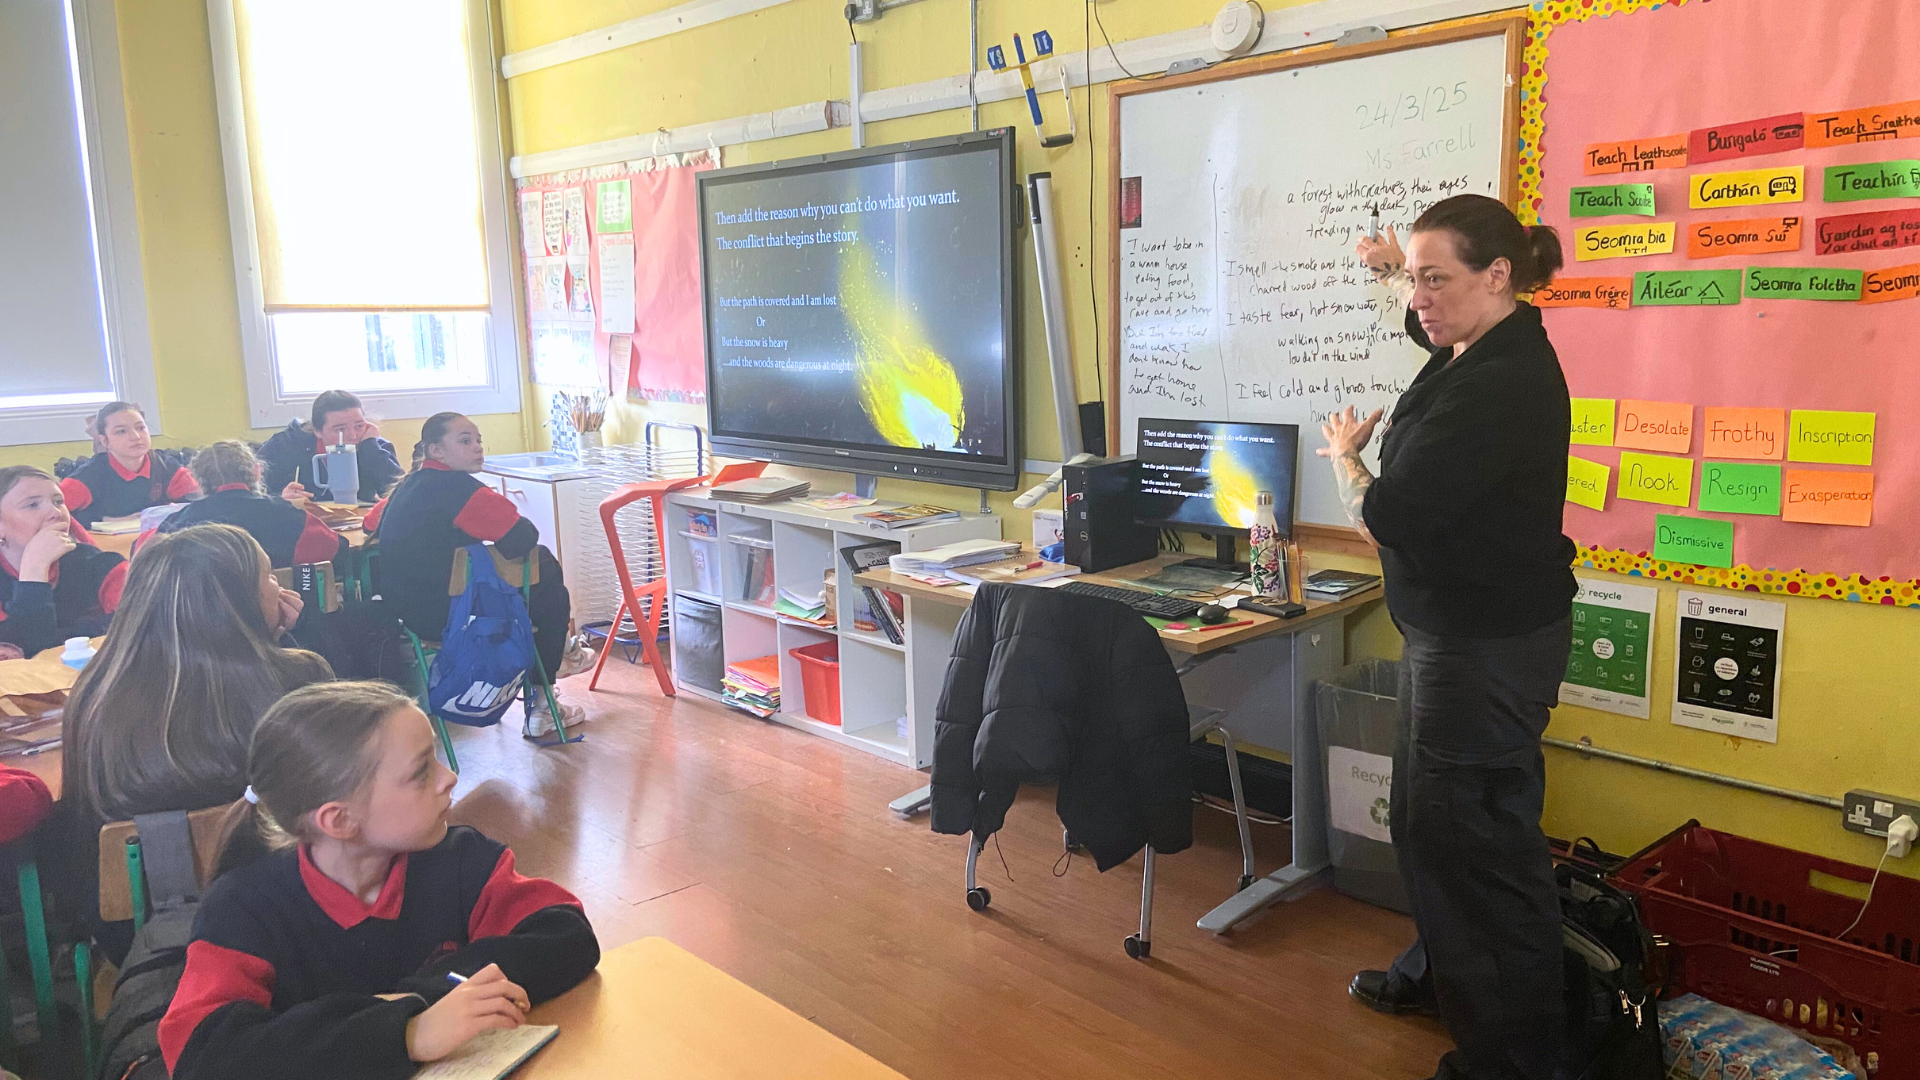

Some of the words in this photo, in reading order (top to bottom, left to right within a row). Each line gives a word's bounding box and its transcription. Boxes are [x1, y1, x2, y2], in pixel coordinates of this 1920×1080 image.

[1356, 81, 1467, 130] 24/3/25
[1817, 116, 1867, 138] Teach
[1707, 128, 1767, 153] Bungaló
[1587, 146, 1627, 168] Teach
[1288, 192, 1294, 204] a
[1302, 180, 1332, 203] forest
[1337, 180, 1359, 200] with
[1411, 177, 1432, 196] their
[1834, 169, 1907, 191] Teachín
[715, 211, 737, 226] Then
[738, 208, 753, 224] add
[754, 205, 769, 222] the
[770, 208, 799, 221] reason
[800, 202, 819, 221] why
[820, 204, 838, 220] you
[840, 197, 863, 215] can't
[864, 196, 878, 212] do
[879, 193, 906, 210] what
[906, 195, 927, 213] you
[929, 189, 960, 205] want.
[1575, 188, 1624, 207] Teach
[716, 237, 733, 251] The
[733, 234, 765, 250] conflict
[766, 232, 784, 248] that
[785, 231, 815, 250] begins
[816, 228, 832, 244] the
[833, 230, 859, 246] story.
[1142, 239, 1167, 253] want
[1306, 223, 1352, 247] treading
[1585, 231, 1644, 251] Seomra
[1648, 229, 1667, 245] bia
[1698, 226, 1760, 247] Seomra
[1166, 257, 1188, 271] house
[1225, 260, 1237, 277] I
[1237, 261, 1267, 279] smell
[1272, 261, 1289, 273] the
[1290, 257, 1318, 273] smoke
[1320, 259, 1336, 270] and
[1340, 255, 1356, 272] the
[1291, 278, 1317, 292] wood
[1341, 274, 1358, 286] the
[1750, 271, 1802, 291] Seomra
[1866, 273, 1920, 294] Seomr
[719, 296, 731, 307] But
[731, 296, 742, 307] the
[742, 295, 758, 310] path
[758, 296, 765, 307] is
[765, 294, 790, 307] covered
[791, 294, 805, 306] and
[805, 294, 810, 306] I
[810, 297, 822, 306] am
[823, 293, 837, 306] lost
[1150, 293, 1162, 303] out
[1164, 291, 1174, 302] of
[755, 316, 766, 327] Or
[1154, 306, 1173, 318] and
[1226, 312, 1237, 327] I
[1239, 308, 1272, 325] taste
[1309, 300, 1329, 317] hot
[721, 336, 733, 347] But
[733, 336, 744, 347] the
[744, 338, 761, 348] snow
[762, 337, 768, 348] is
[768, 336, 789, 351] heavy
[1130, 342, 1148, 350] and
[1277, 333, 1320, 355] walking
[1323, 335, 1334, 345] on
[741, 356, 753, 368] the
[753, 357, 774, 369] woods
[774, 360, 786, 369] are
[786, 357, 822, 373] dangerous
[822, 360, 830, 371] at
[831, 360, 853, 374] night.
[1321, 352, 1330, 362] in
[1330, 352, 1348, 363] the
[1350, 347, 1371, 362] wind
[1180, 391, 1207, 408] lost
[1235, 383, 1250, 400] I
[1308, 377, 1330, 394] and
[1334, 376, 1366, 403] gloves
[1624, 412, 1689, 436] Desolate
[1799, 422, 1873, 447] Inscription
[1143, 429, 1157, 437] Then
[1167, 430, 1176, 438] the
[1193, 432, 1203, 441] why
[1235, 434, 1249, 442] what
[1248, 436, 1259, 444] you
[1711, 420, 1776, 456] Frothy
[1629, 463, 1679, 492] Nook
[1709, 468, 1768, 501] Resign
[1788, 484, 1873, 506] Exasperation
[1658, 525, 1724, 551] Dismissive
[302, 567, 311, 591] NIKE
[1588, 590, 1622, 601] recycle
[1708, 604, 1748, 618] general
[1351, 765, 1392, 788] Recyc
